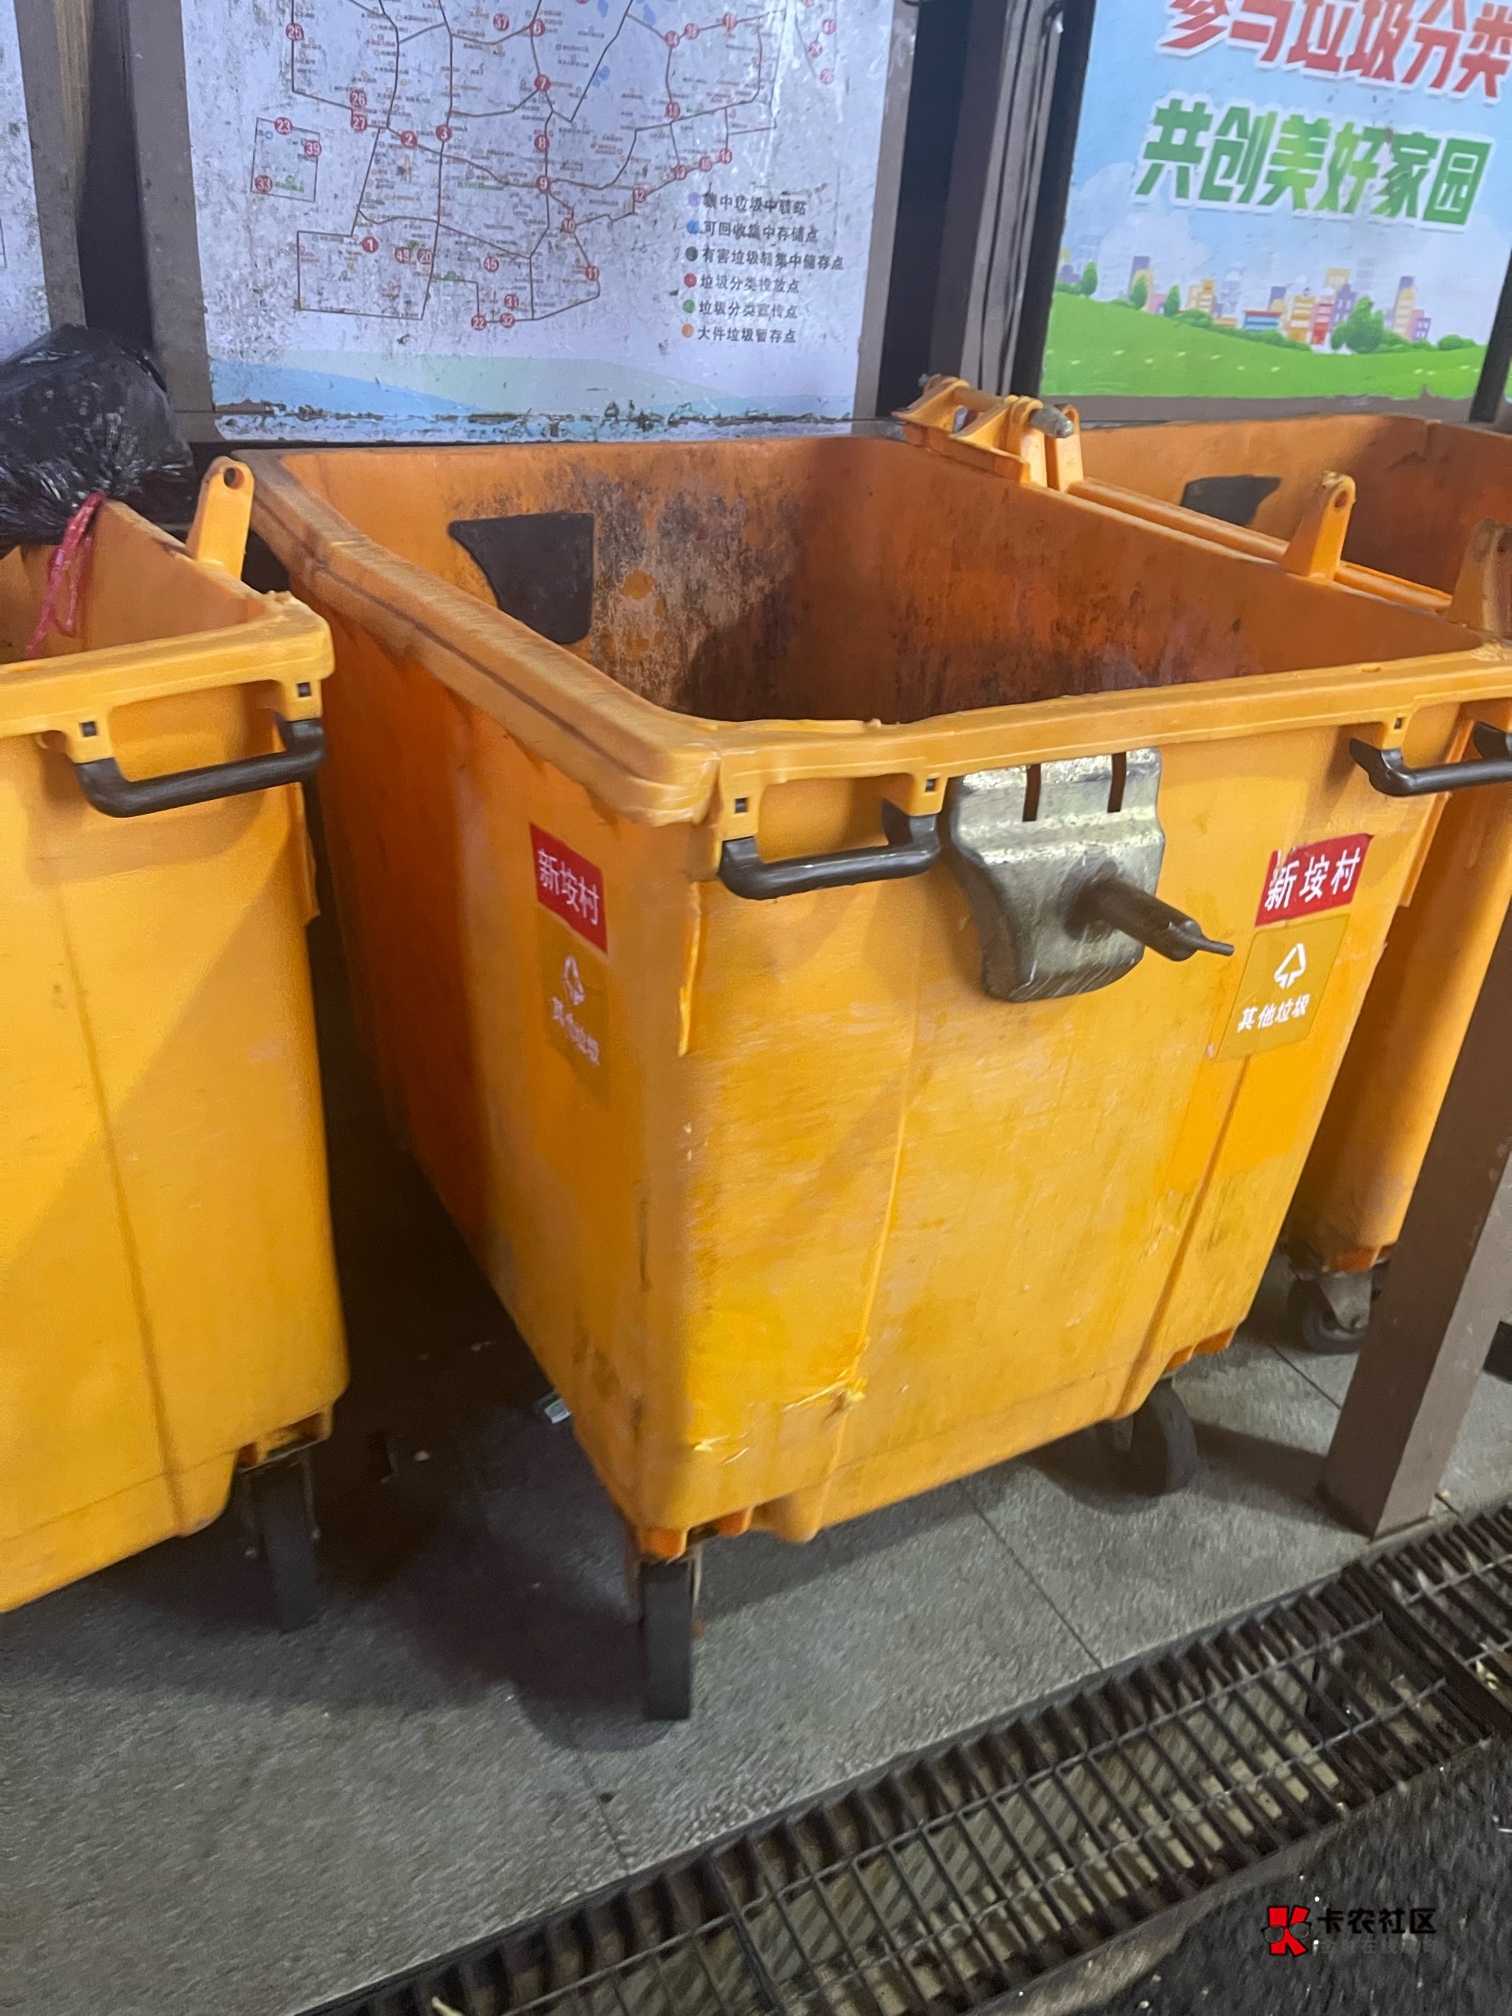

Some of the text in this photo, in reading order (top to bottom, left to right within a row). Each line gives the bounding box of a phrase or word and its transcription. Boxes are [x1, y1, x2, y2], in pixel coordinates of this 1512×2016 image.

[494, 14, 508, 30] 37
[288, 25, 302, 39] 25
[351, 92, 366, 105] 26
[276, 119, 291, 132] 23
[353, 116, 366, 130] 27
[306, 142, 321, 155] 39
[1135, 98, 1494, 226] 共创美好家园
[256, 177, 271, 191] 33
[632, 189, 646, 202] 12
[419, 249, 432, 262] 20
[485, 257, 498, 271] 45
[700, 274, 801, 294] 垃圾分类投放点
[698, 300, 799, 319] 垃圾分类宣传点
[472, 316, 485, 329] 22
[500, 314, 514, 327] 32
[697, 324, 797, 344] 大件垃圾暂存点
[1264, 846, 1361, 911] 新垵村
[537, 847, 601, 927] 新垵村
[1236, 993, 1311, 1034] 其他垃圾
